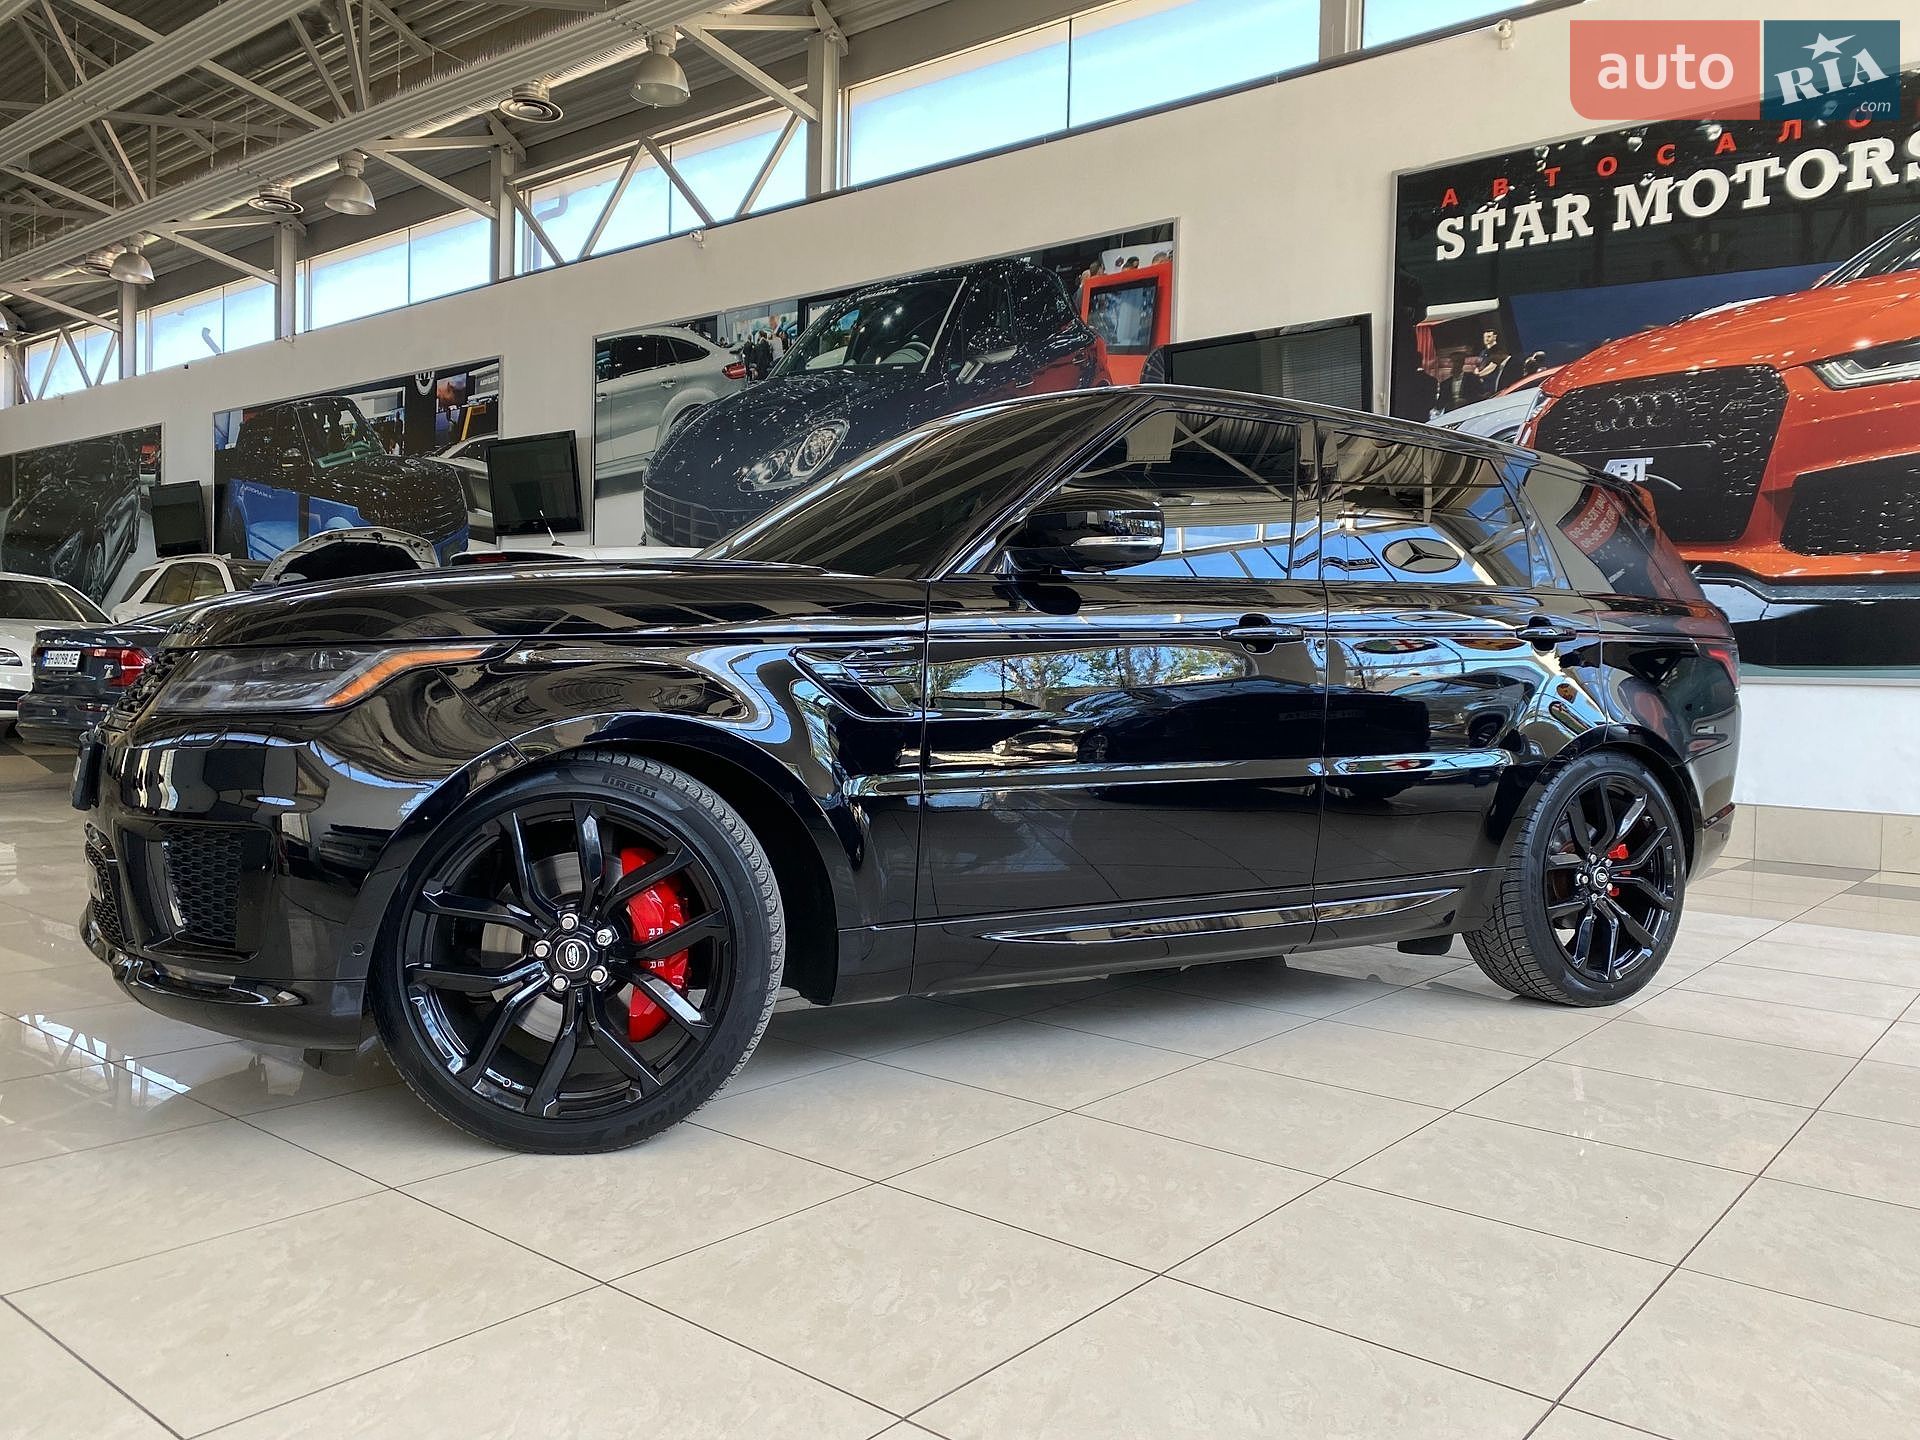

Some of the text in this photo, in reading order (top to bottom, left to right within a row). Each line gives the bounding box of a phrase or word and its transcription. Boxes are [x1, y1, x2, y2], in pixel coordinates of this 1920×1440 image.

[1441, 98, 1920, 208] АВТОСАЛО
[1436, 194, 1594, 261] STAR
[601, 775, 658, 799] PIRELLI
